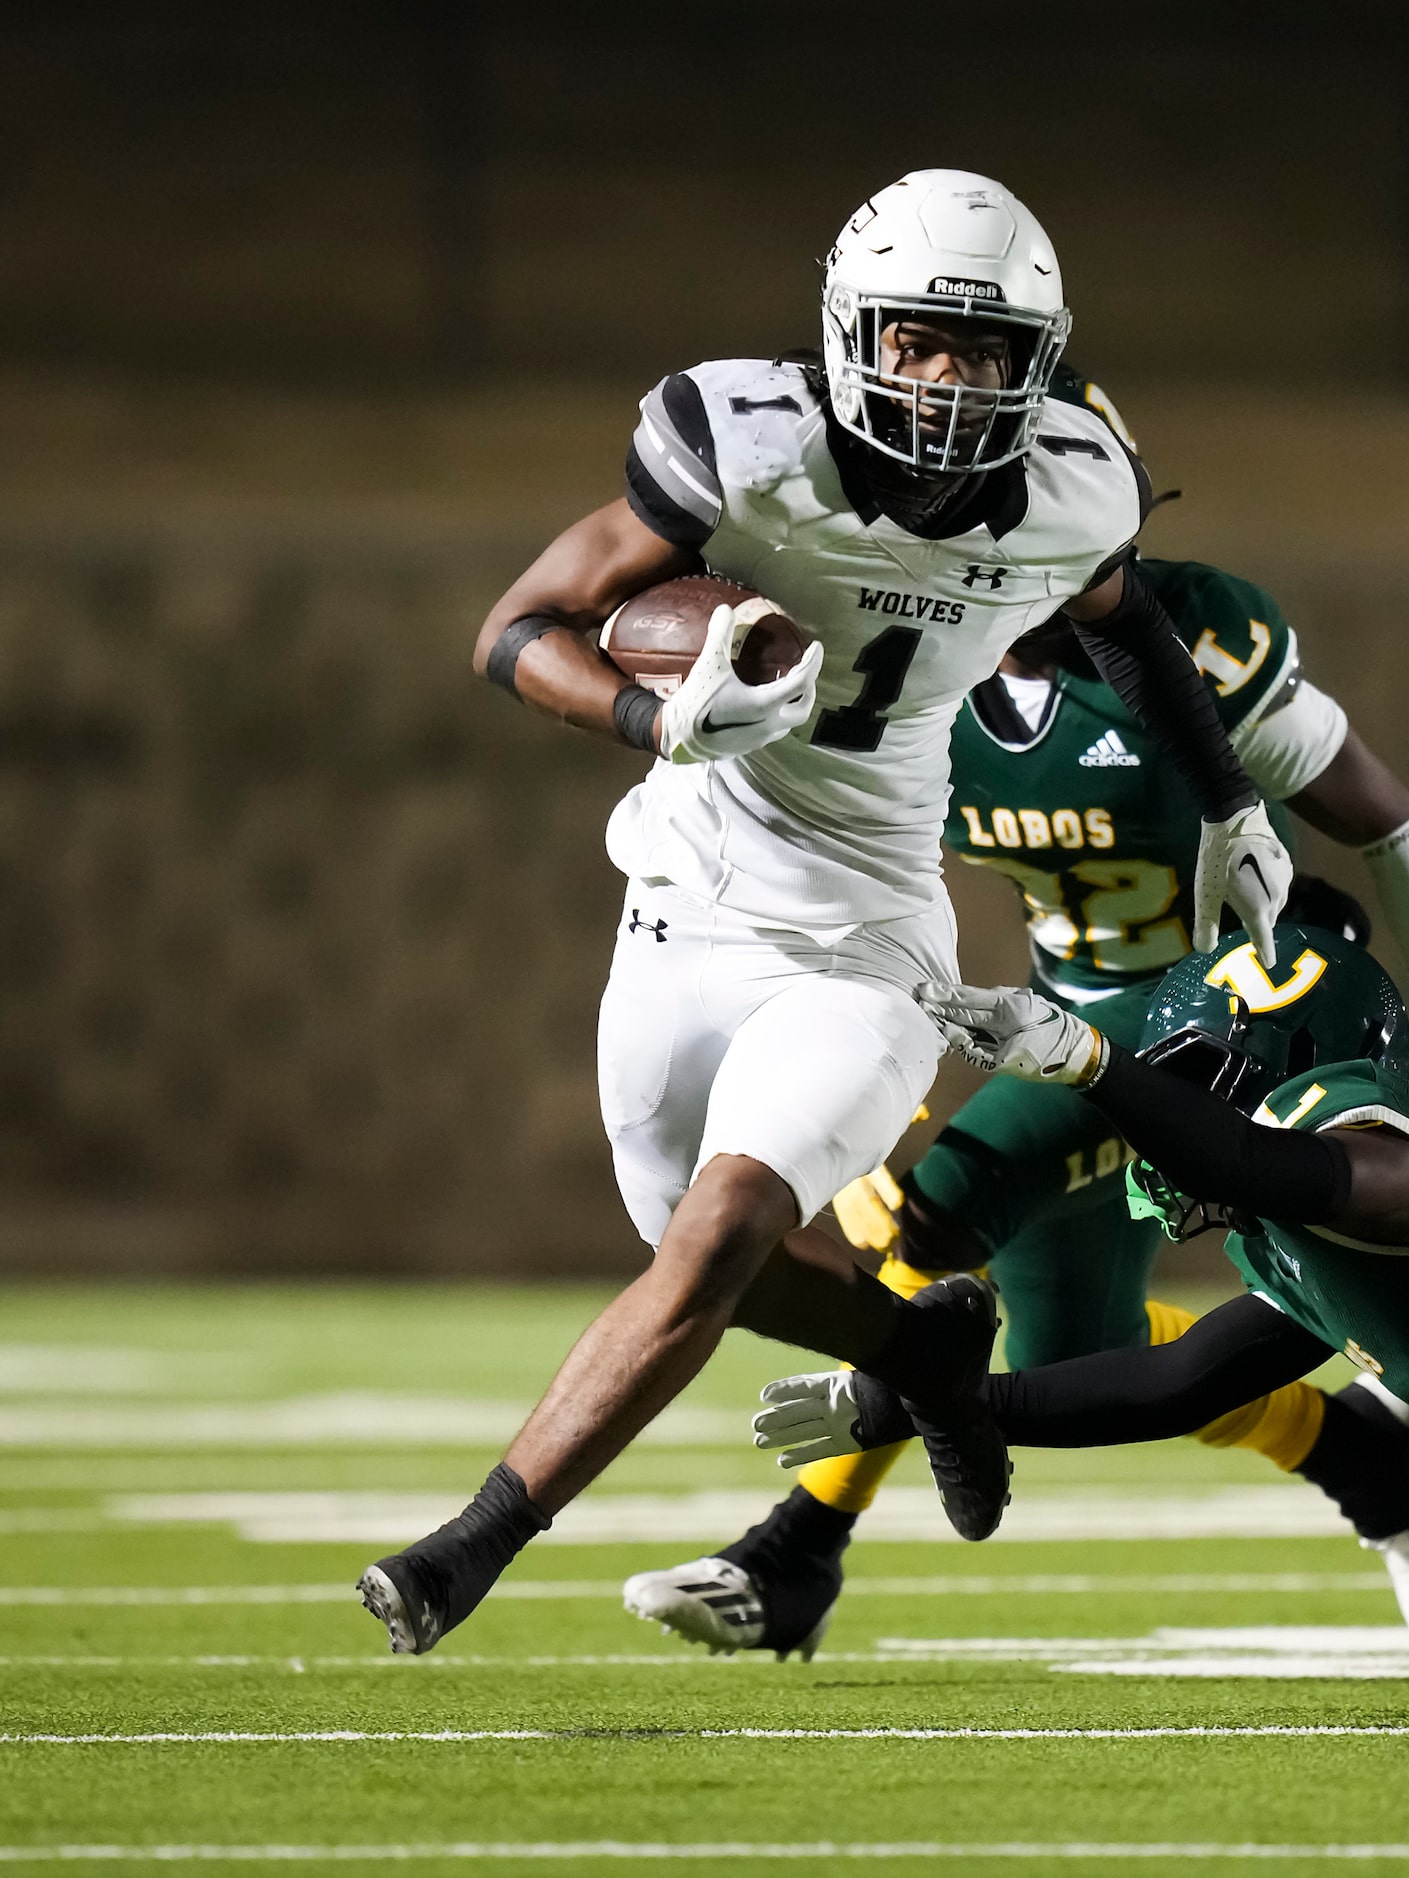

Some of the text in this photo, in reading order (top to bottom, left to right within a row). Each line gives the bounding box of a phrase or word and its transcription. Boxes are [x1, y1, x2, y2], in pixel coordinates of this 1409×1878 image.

[934, 278, 998, 298] Riddell
[728, 394, 804, 418] 1
[858, 587, 966, 625] WOLVES
[1192, 618, 1271, 698] L
[809, 624, 924, 753] 1
[1078, 752, 1141, 768] adidas
[959, 805, 1116, 849] LOBOS
[1202, 941, 1329, 1015] L
